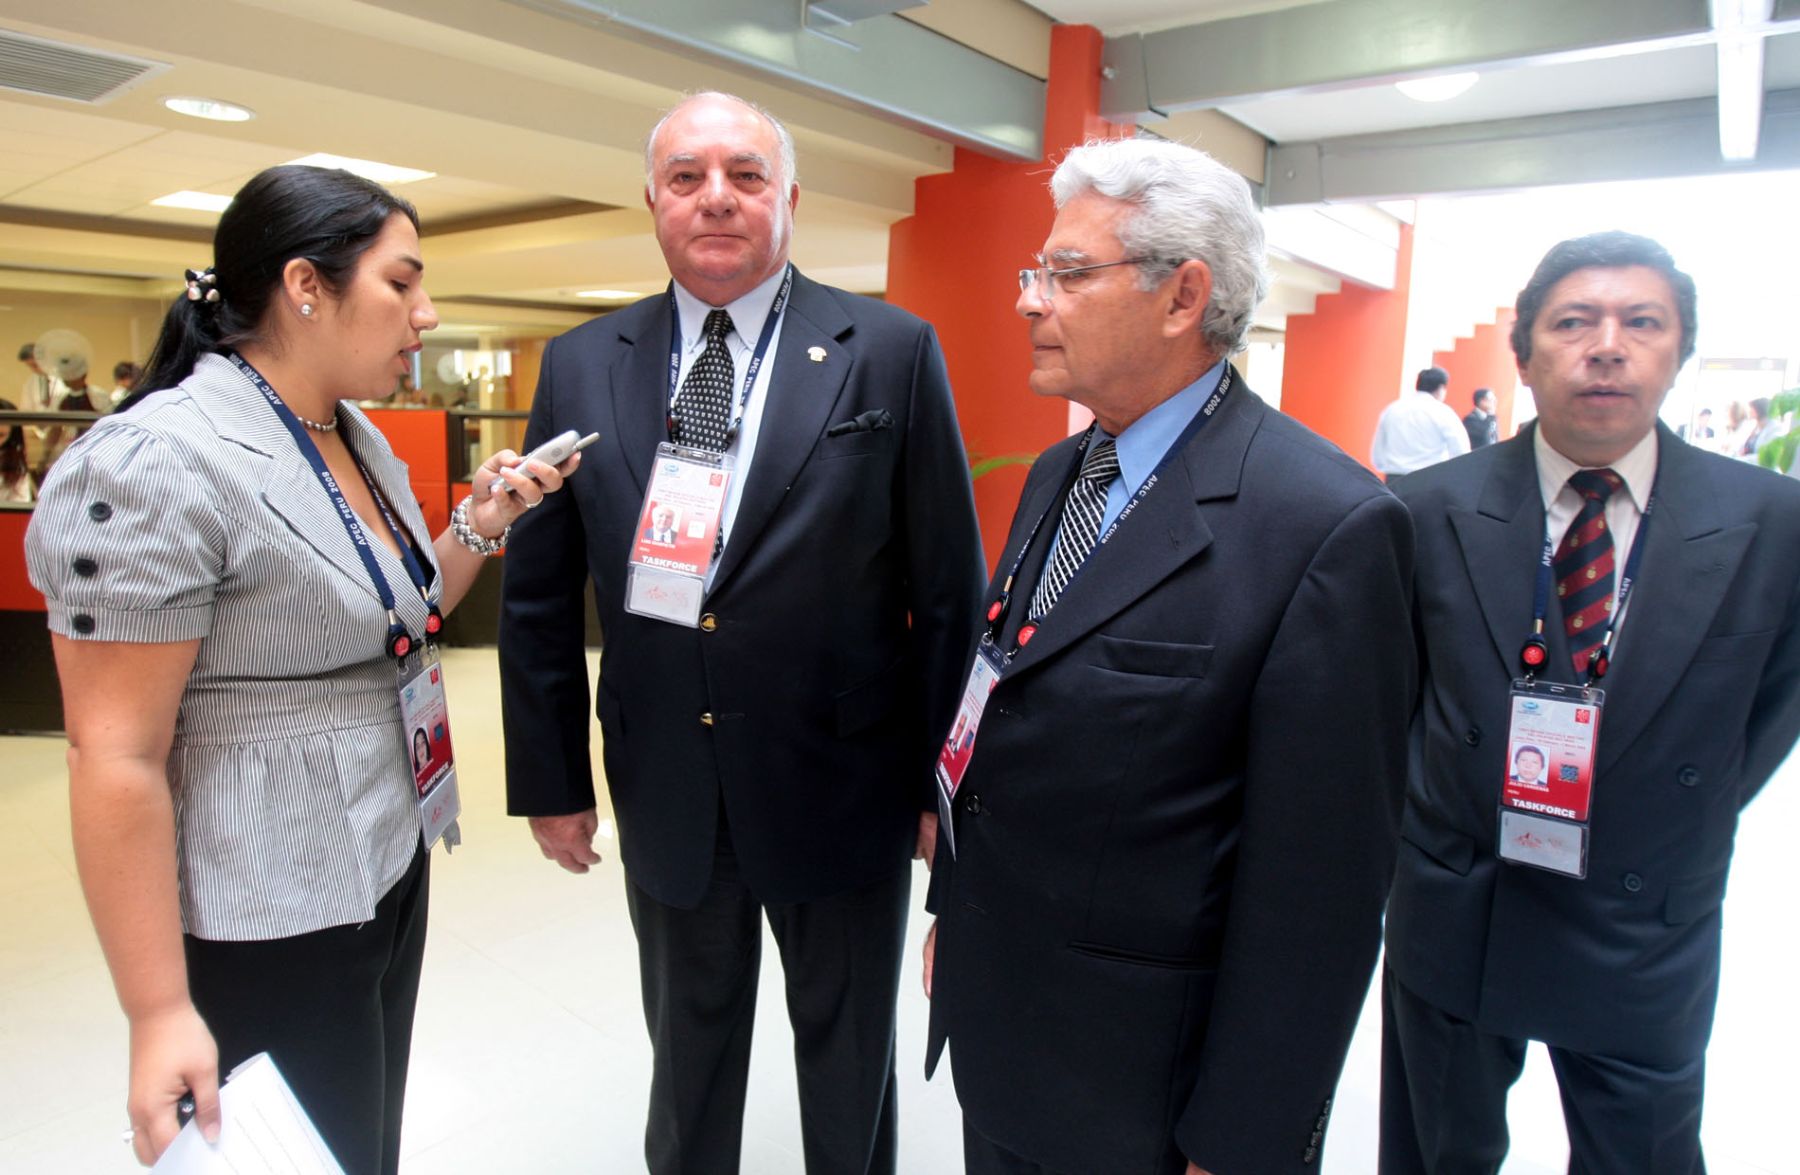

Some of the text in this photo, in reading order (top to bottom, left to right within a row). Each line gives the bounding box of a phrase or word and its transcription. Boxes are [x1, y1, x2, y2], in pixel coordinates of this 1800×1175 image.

[241, 365, 263, 384] PERU
[260, 385, 283, 405] APEC
[1203, 375, 1232, 416] PERU 2008
[1138, 474, 1159, 497] APEC
[321, 471, 367, 546] APEC PERU 2008
[641, 555, 698, 573] TASKFORCE
[1511, 798, 1576, 819] TASKFORCE
